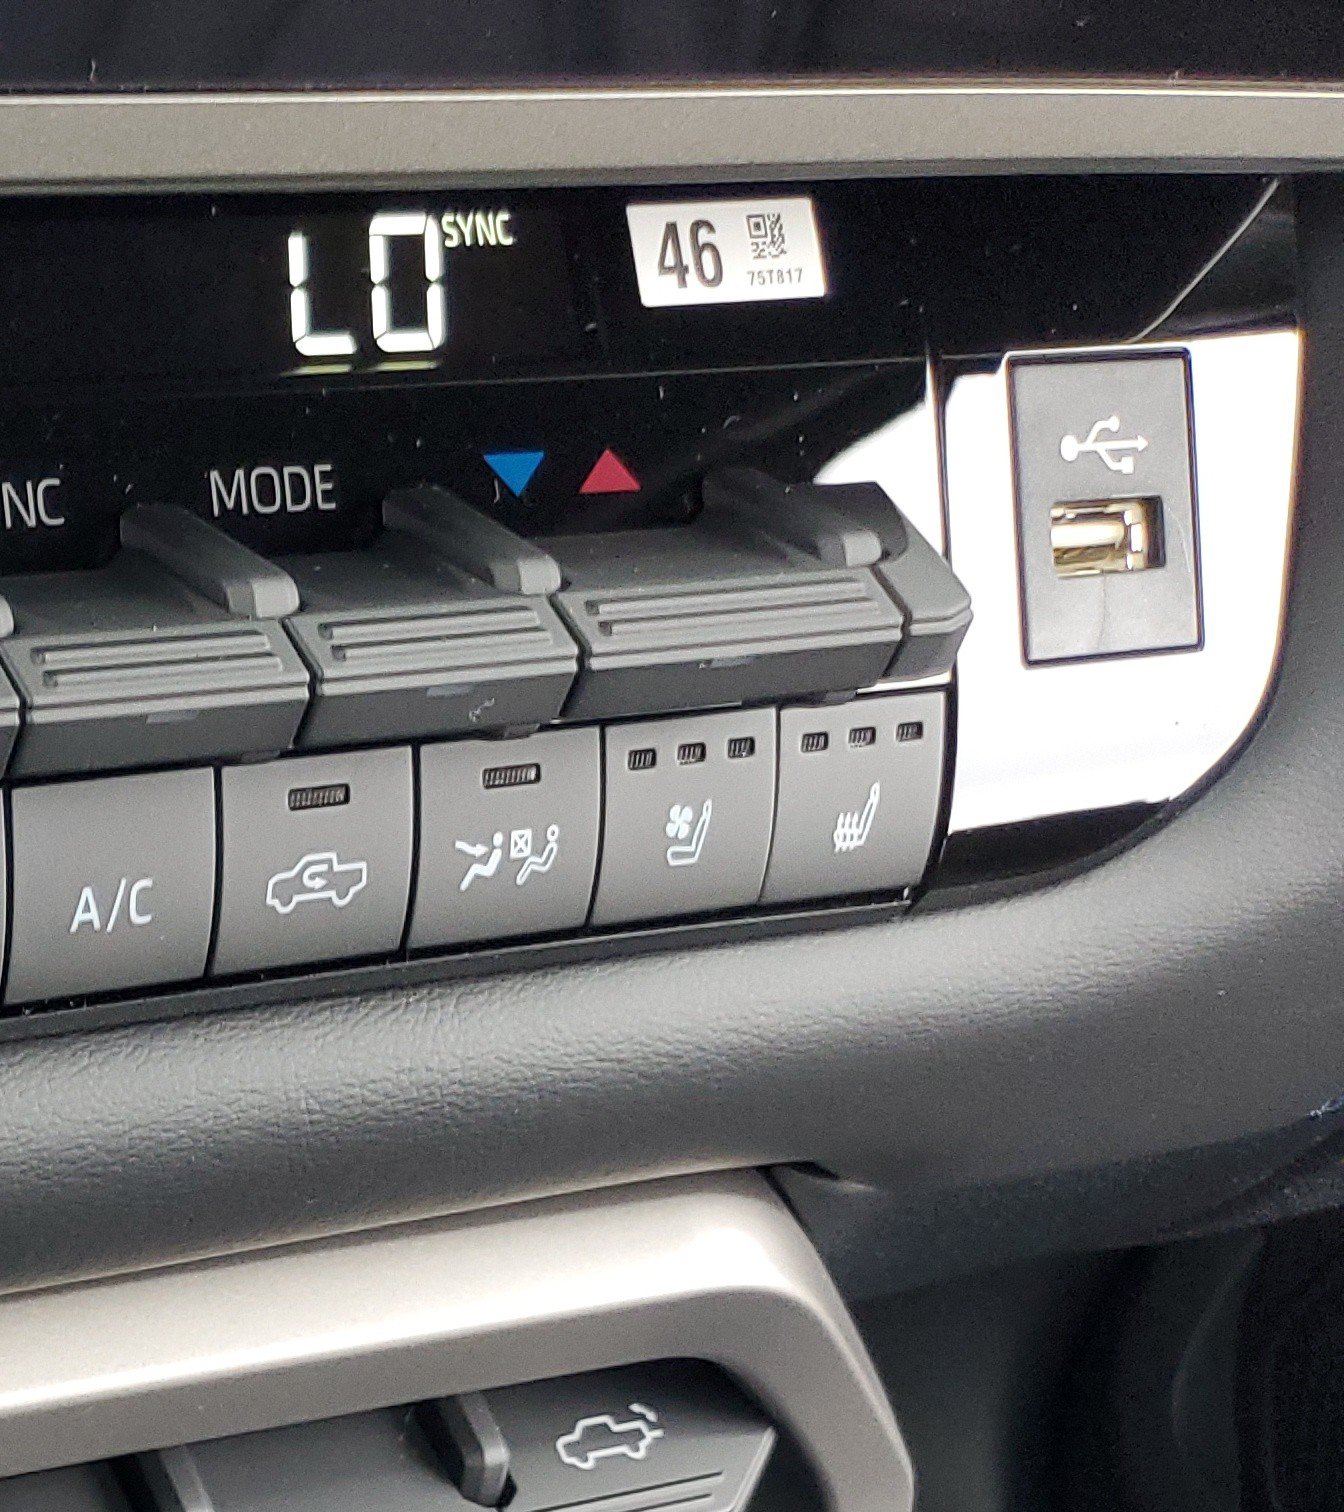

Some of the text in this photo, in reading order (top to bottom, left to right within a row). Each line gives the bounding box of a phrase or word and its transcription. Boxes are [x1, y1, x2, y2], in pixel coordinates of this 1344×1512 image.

[441, 209, 515, 247] SYNC
[657, 219, 723, 289] 46
[209, 463, 337, 517] MODE
[69, 877, 154, 933] A/C
